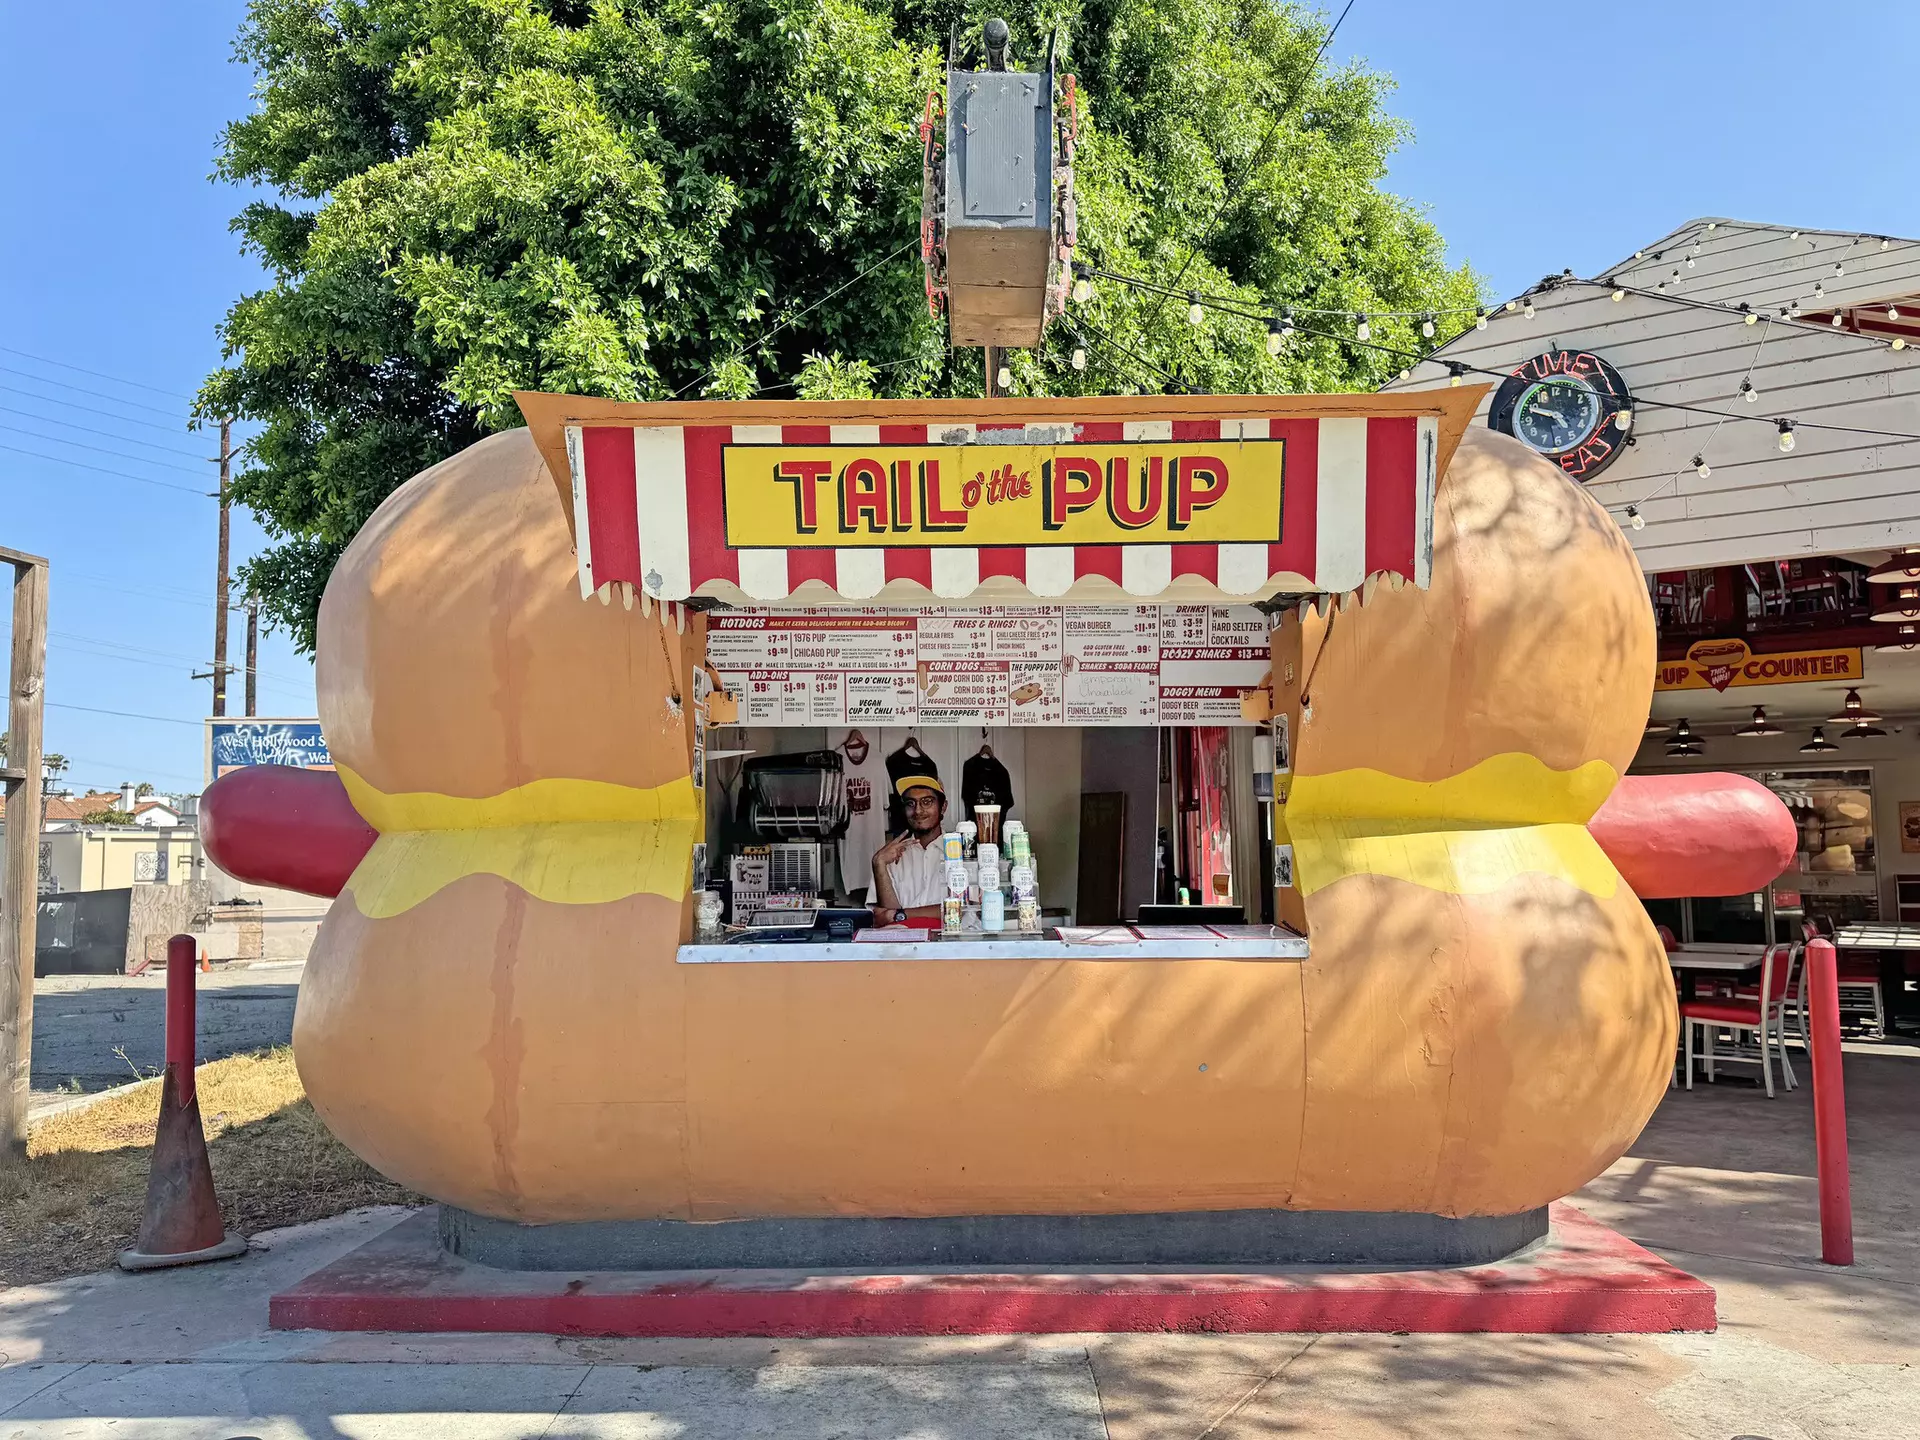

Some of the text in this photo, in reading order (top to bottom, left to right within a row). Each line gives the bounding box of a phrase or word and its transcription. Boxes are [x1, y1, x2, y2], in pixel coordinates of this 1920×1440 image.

[1551, 387, 1560, 396] 12
[1577, 394, 1584, 404] 2
[1581, 406, 1588, 416] 3
[1525, 416, 1532, 426] 9
[1577, 419, 1585, 429] 4
[1530, 427, 1537, 437] 8
[1567, 431, 1576, 441] 5
[1541, 434, 1548, 444] 7
[1554, 436, 1561, 446] 6
[773, 458, 968, 535] TAIL
[1042, 456, 1229, 532] PUP
[1175, 605, 1207, 613] DRINKS
[1212, 609, 1230, 618] WINE
[719, 618, 766, 629] HOTDOGS
[952, 619, 976, 628] FRIES
[987, 620, 1017, 628] RINGS!
[1065, 622, 1086, 630] VEGAN
[1087, 622, 1112, 630] BURGER
[1211, 622, 1263, 632] HARD SELTZER
[812, 633, 826, 643] PUP
[1211, 635, 1250, 645] COCKTAILS
[794, 648, 825, 658] CHICAGO
[826, 648, 840, 658] PUP
[1194, 648, 1232, 659] SHAKES
[928, 661, 980, 671] CORN DOGS
[1011, 663, 1058, 672] THE PUPPY DOG
[1710, 666, 1727, 676] THIS
[1743, 654, 1850, 679] COUNTER
[749, 671, 788, 680] ADD-ONS
[928, 675, 953, 683] JUMBO
[953, 674, 971, 682] CORN
[971, 674, 985, 682] DOG
[1711, 672, 1731, 686] WAY!
[953, 685, 971, 694] CORN
[971, 685, 985, 694] DOG
[1162, 687, 1222, 697] DOGGY MENU
[1161, 701, 1182, 710] DOGGY
[1183, 701, 1199, 710] BEER
[848, 707, 863, 715] CUP
[874, 707, 893, 715] CHILI
[919, 709, 948, 717] CHICKEN
[949, 709, 979, 717] POPPERS
[1067, 707, 1128, 715] FUNNEL CAKE FRIES
[1161, 711, 1182, 720] DOGGY
[1183, 711, 1196, 720] DOG
[252, 734, 315, 752] Hollywood
[735, 903, 760, 911] TAIL
